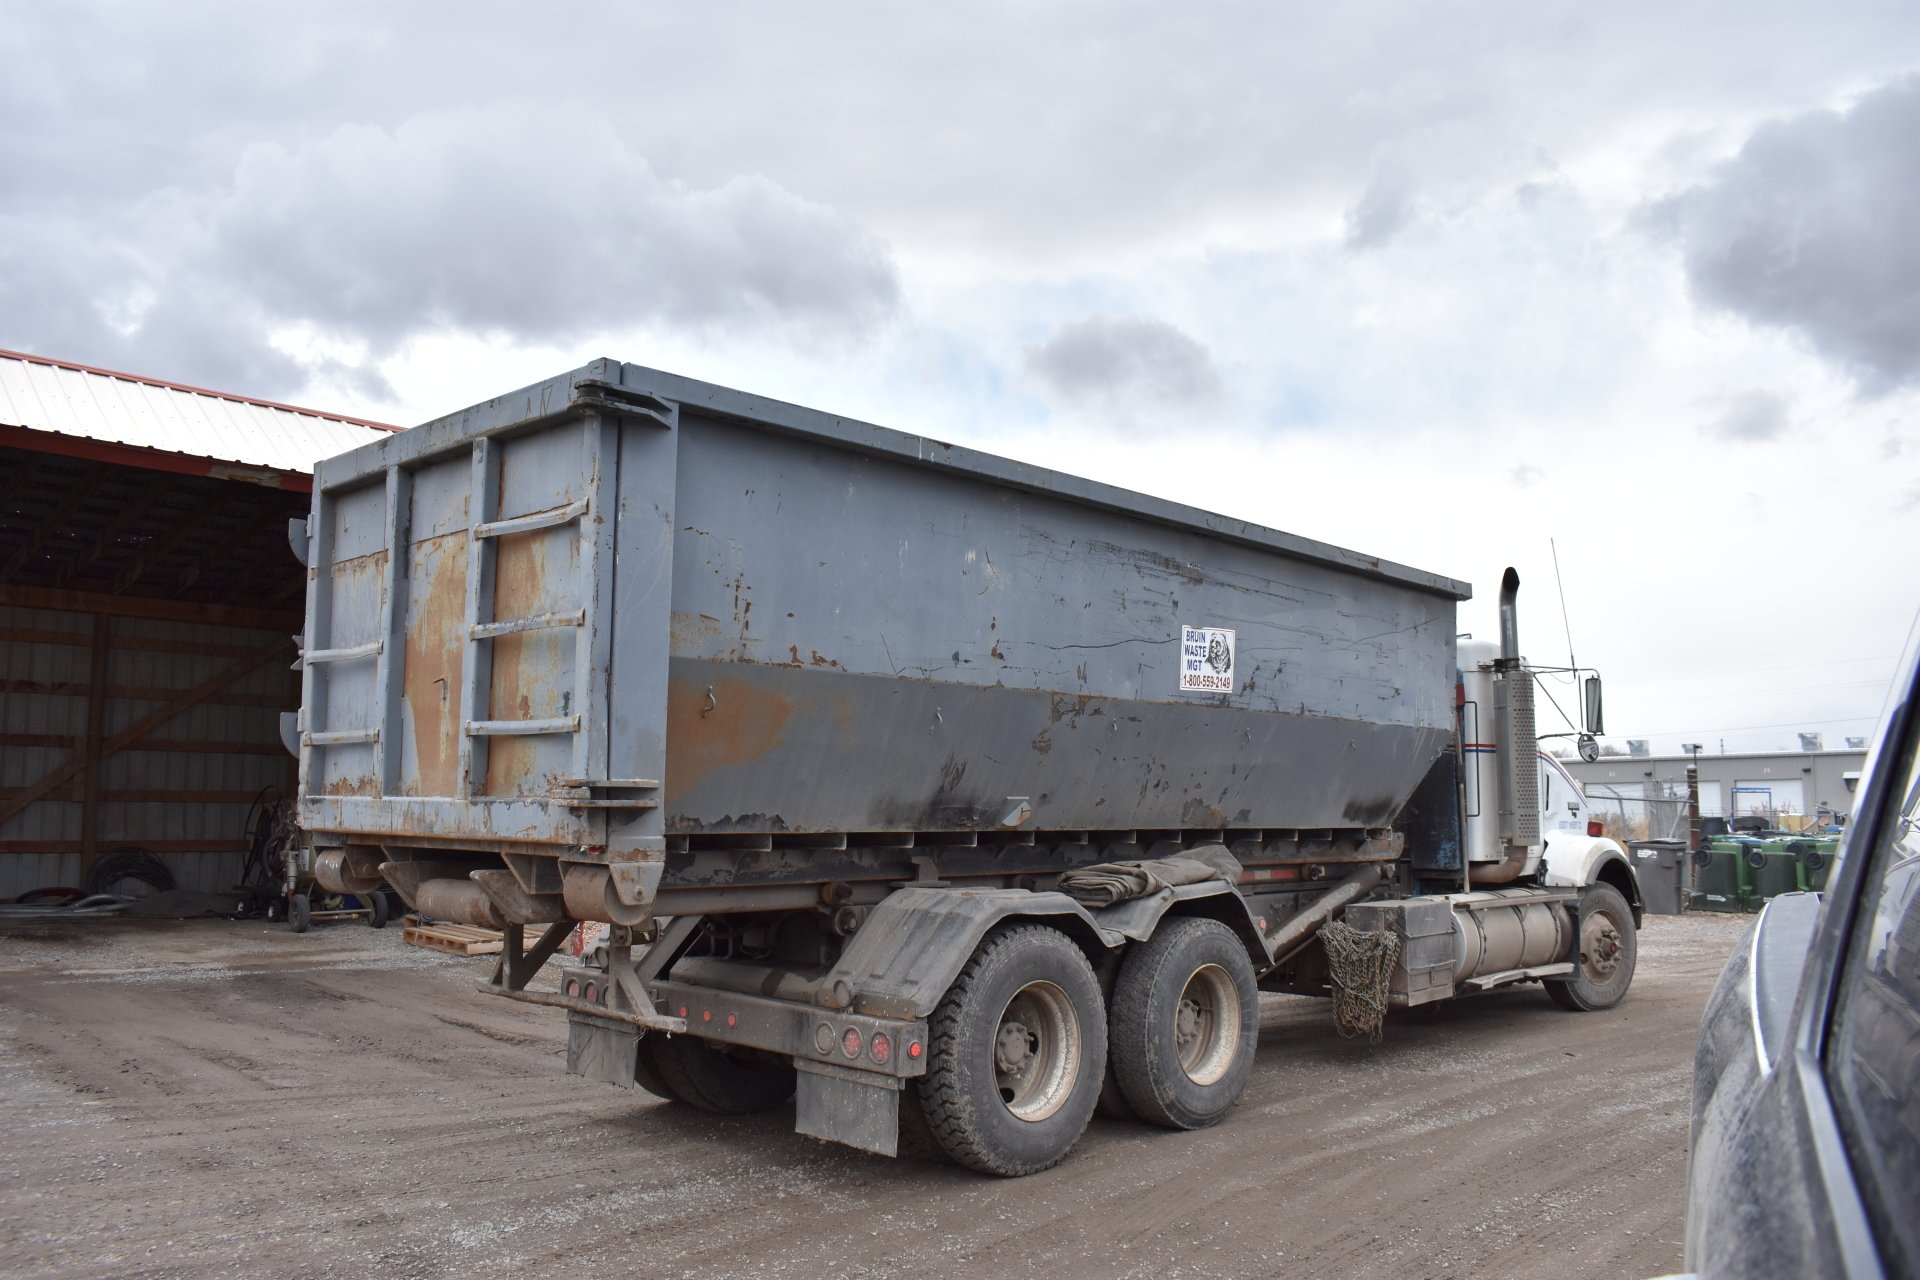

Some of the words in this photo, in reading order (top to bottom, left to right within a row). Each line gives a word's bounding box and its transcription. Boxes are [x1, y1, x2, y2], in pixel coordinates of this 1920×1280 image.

[1186, 630, 1206, 643] BRUIN
[1184, 644, 1206, 657] WASTE
[1186, 659, 1203, 671] MGT
[1183, 673, 1231, 689] 1-800-559-2149
